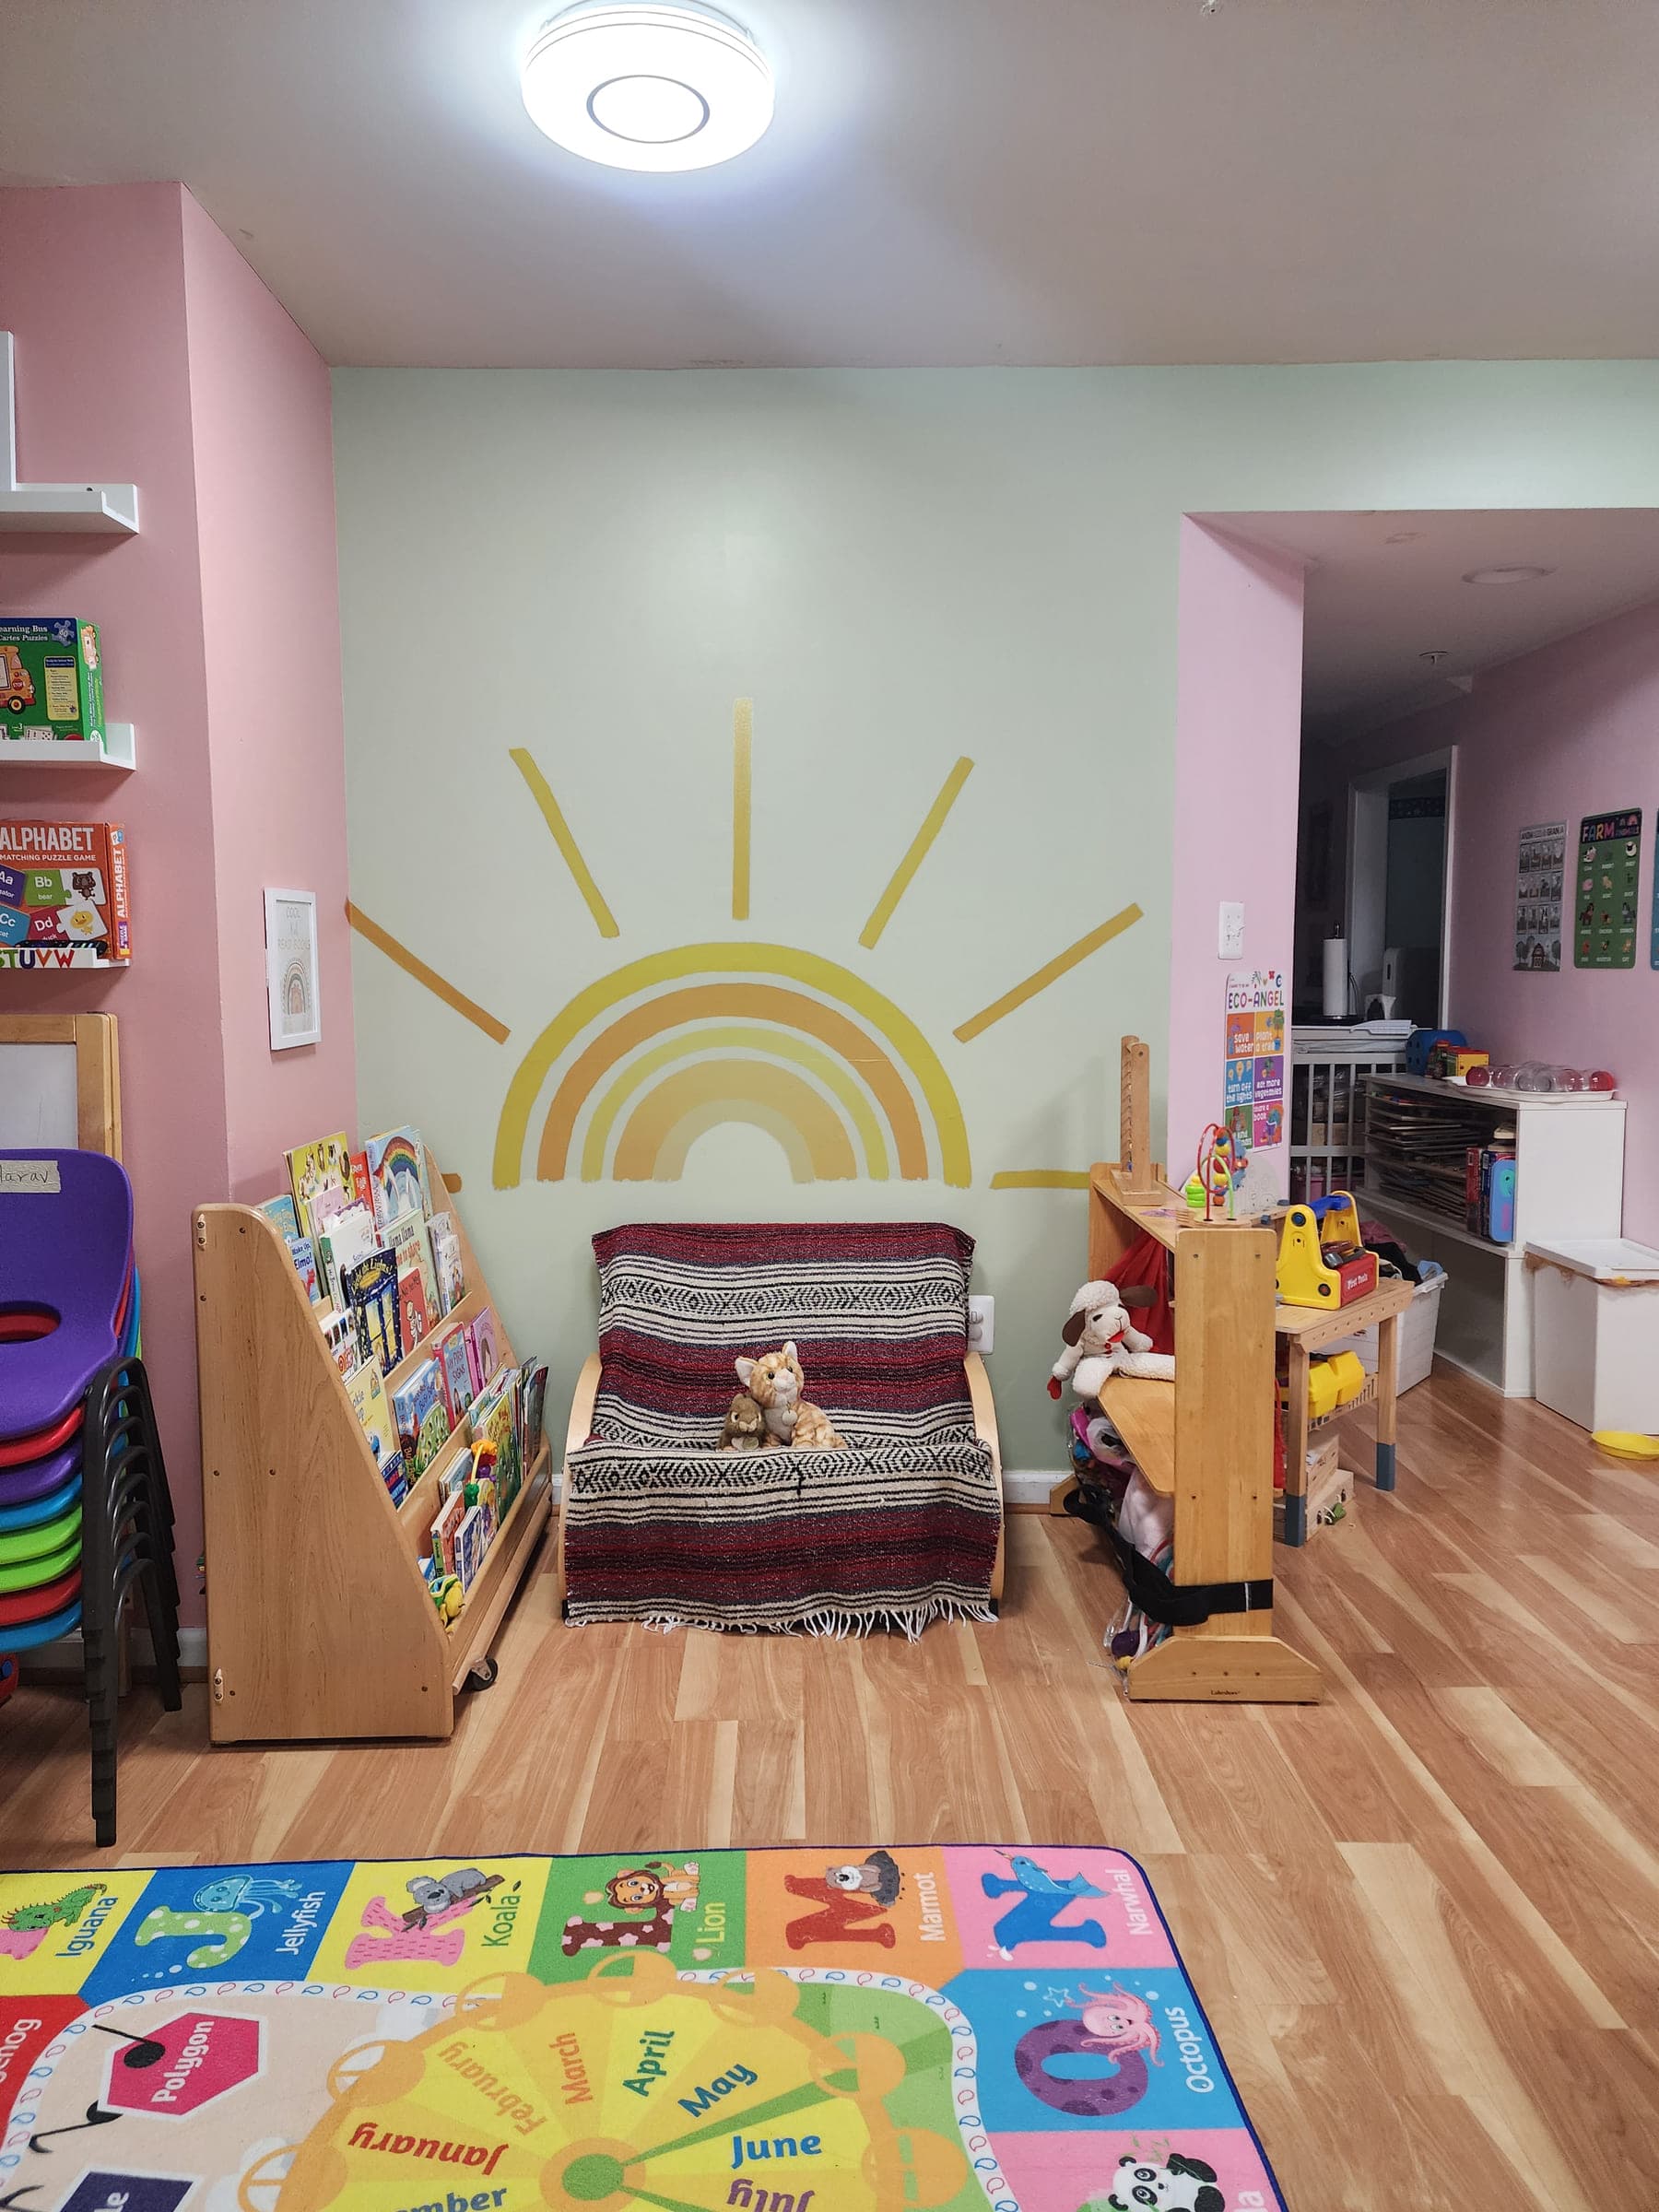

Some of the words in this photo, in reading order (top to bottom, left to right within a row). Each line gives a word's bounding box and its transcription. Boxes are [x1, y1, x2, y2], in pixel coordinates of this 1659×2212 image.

[0, 626, 30, 634] earning
[0, 827, 94, 851] ALPHABET
[1583, 823, 1615, 841] FARM
[35, 877, 53, 888] Bb
[113, 848, 125, 918] ALPHABET
[0, 913, 16, 926] Cc
[34, 916, 53, 932] Dd
[1229, 991, 1285, 1009] ECO-ANGEL
[1234, 1032, 1250, 1043] save
[1235, 1042, 1254, 1053] water
[293, 1251, 312, 1270] Elmo!
[370, 1257, 394, 1274] Lights!
[276, 1891, 326, 1956] Jellyfish
[481, 1893, 522, 1947] Koala
[695, 1901, 726, 1945] Lion
[913, 1872, 947, 1943] Marmot
[981, 1872, 1107, 1949] N
[1105, 1869, 1153, 1935] Narwhal
[55, 1896, 118, 1958] Iguana
[152, 2021, 215, 2103] Polygon
[549, 2031, 594, 2105] March
[622, 2030, 675, 2097] April
[1165, 2006, 1215, 2093] Octopus
[437, 2041, 547, 2136] February
[677, 2064, 759, 2117] May
[347, 2122, 509, 2176] January
[731, 2135, 822, 2170] June
[726, 2178, 815, 2212] July
